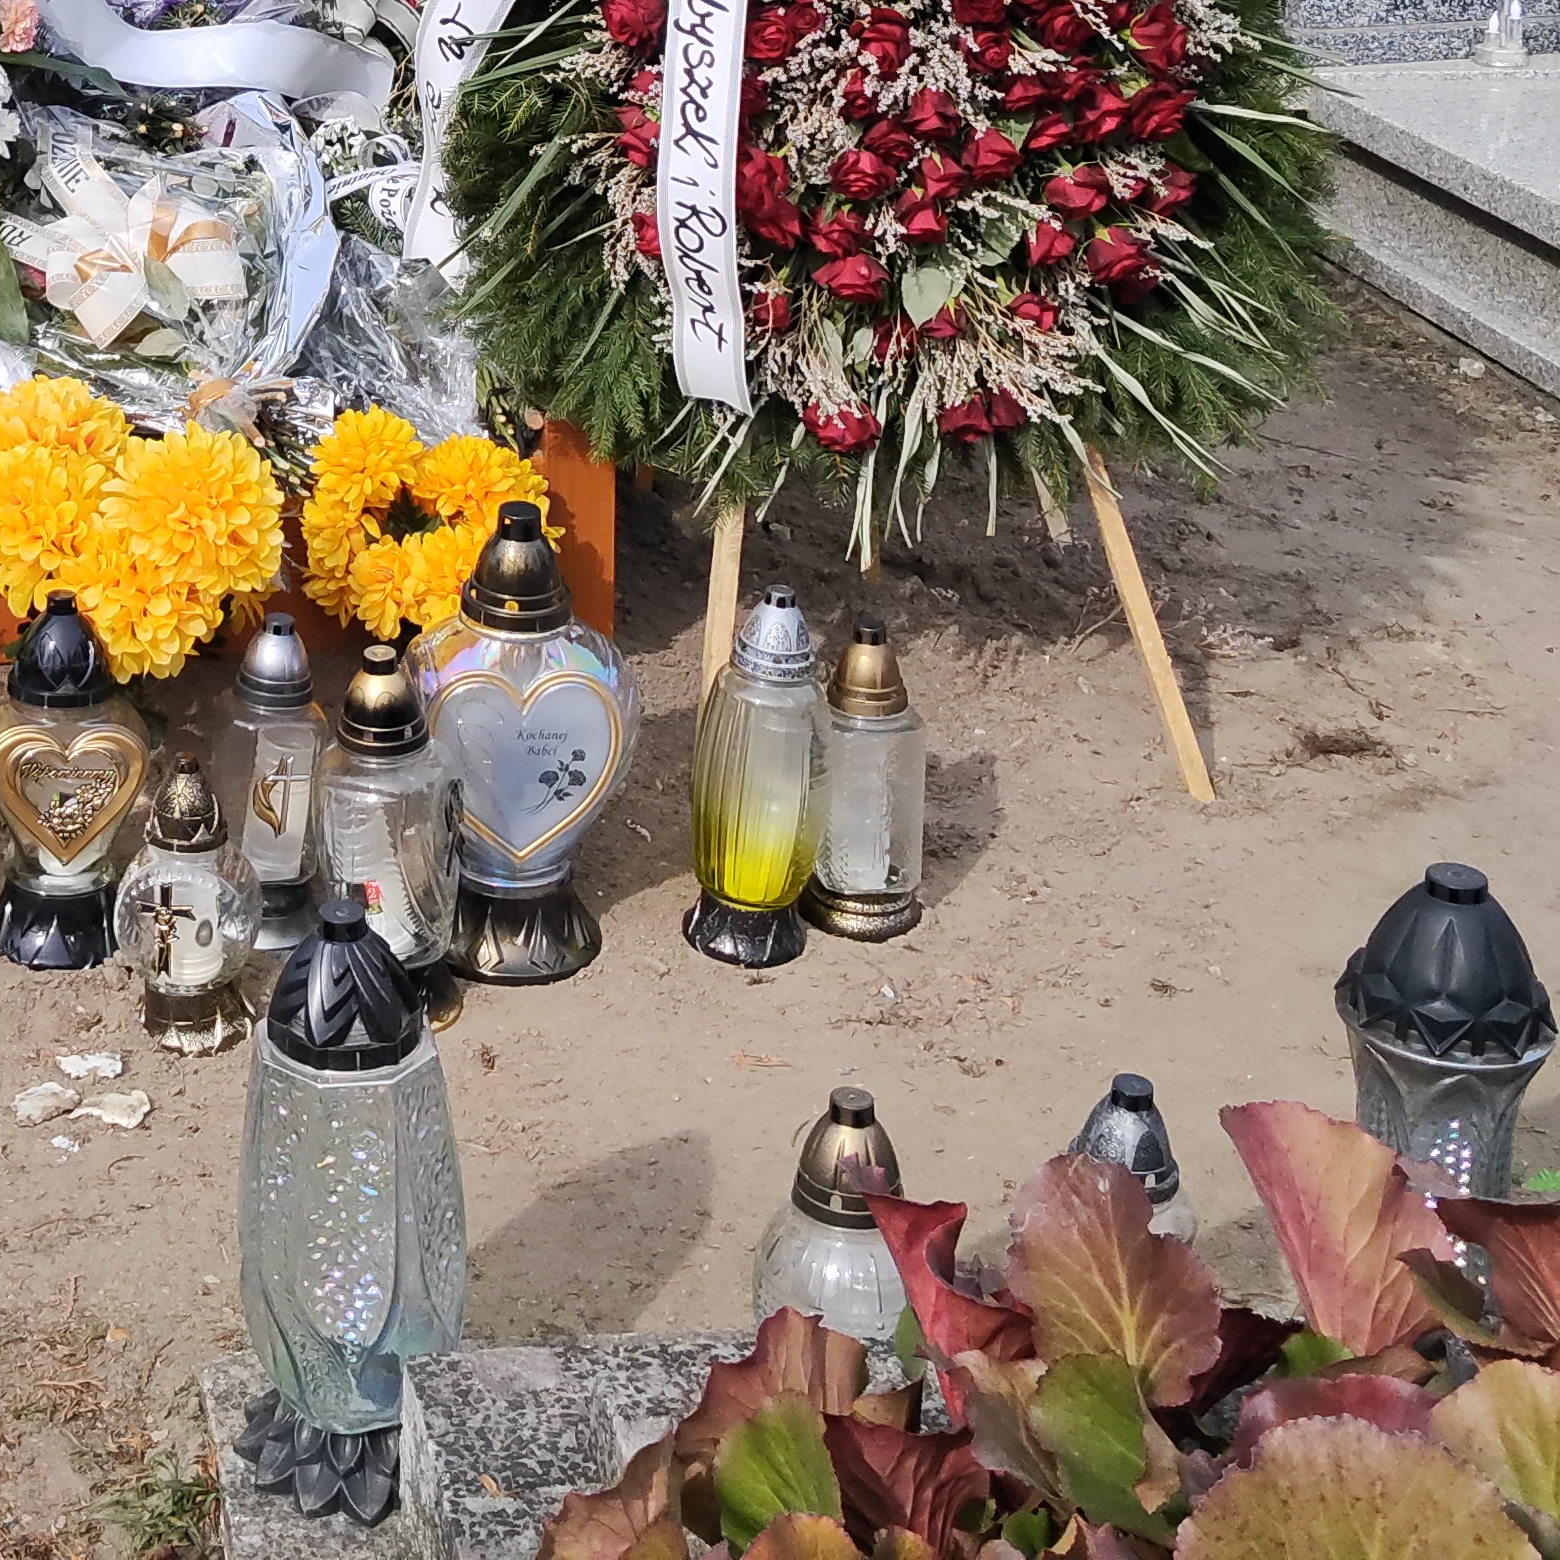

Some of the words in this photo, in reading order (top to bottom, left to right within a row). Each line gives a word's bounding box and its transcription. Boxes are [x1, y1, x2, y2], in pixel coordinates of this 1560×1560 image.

[676, 202, 730, 354] Robert
[515, 728, 569, 743] Kochanej
[526, 744, 558, 757] Babci
